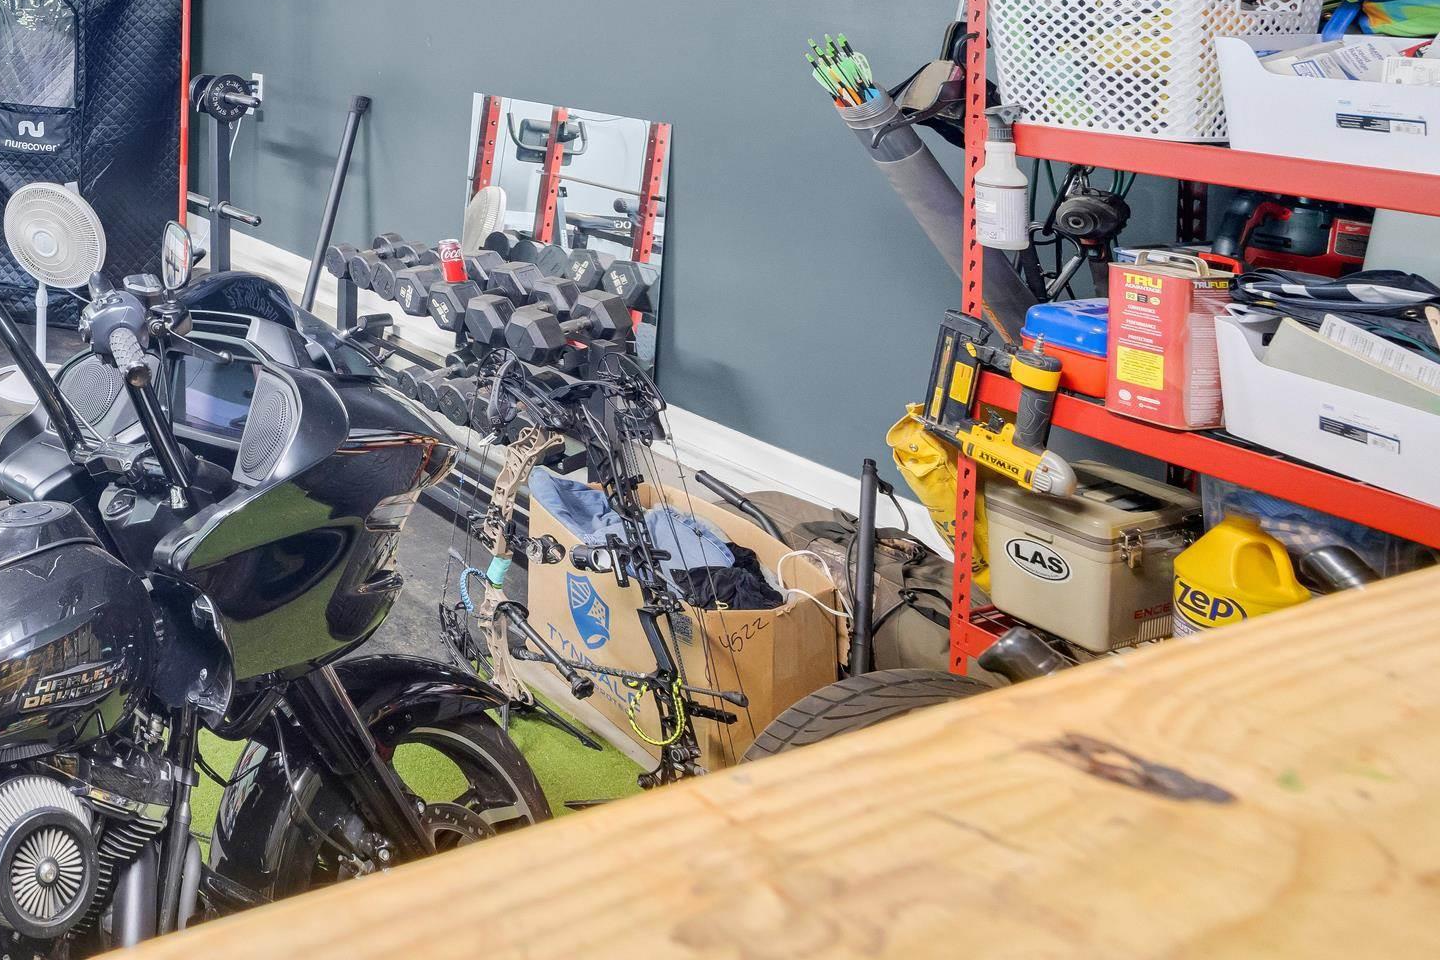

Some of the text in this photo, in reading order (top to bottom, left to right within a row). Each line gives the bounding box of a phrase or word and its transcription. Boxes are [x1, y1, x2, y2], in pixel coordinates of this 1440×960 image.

[4, 138, 58, 152] nurecover
[1123, 272, 1163, 289] TRU
[1014, 542, 1064, 574] LAS
[718, 617, 770, 653] 4522
